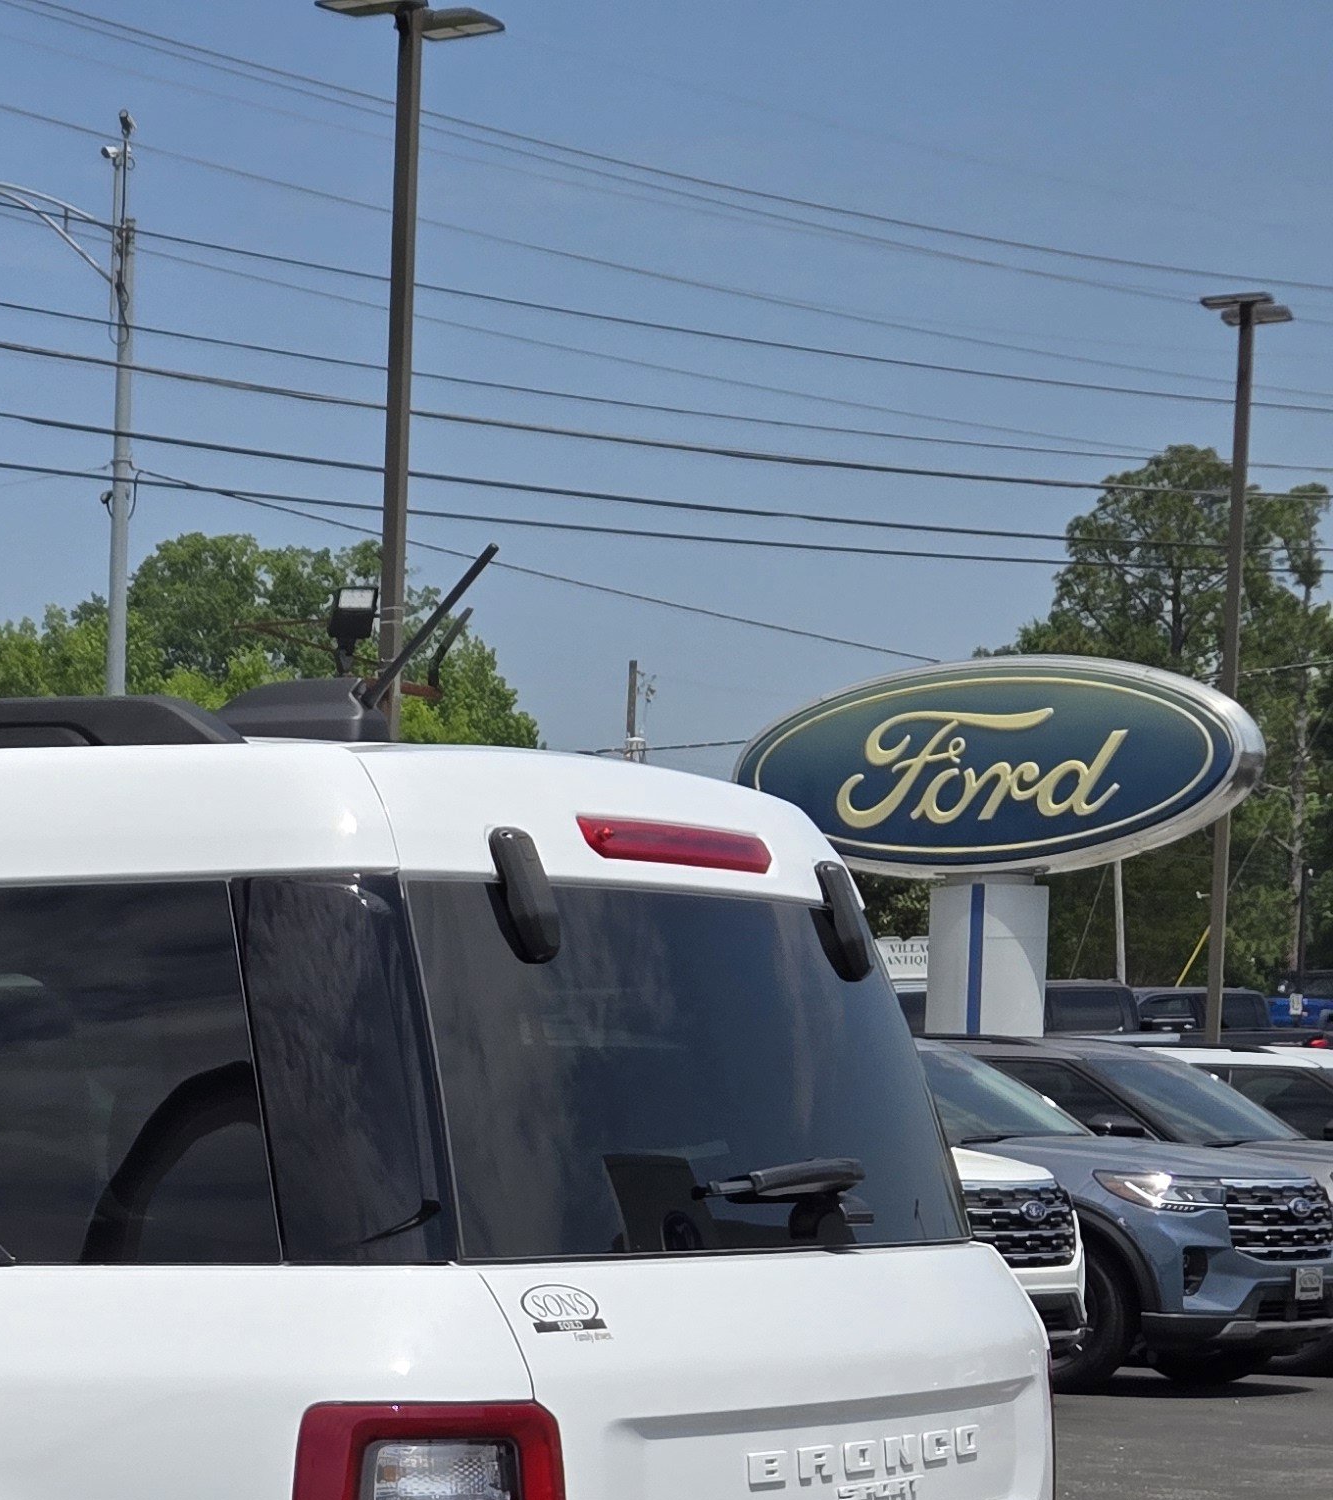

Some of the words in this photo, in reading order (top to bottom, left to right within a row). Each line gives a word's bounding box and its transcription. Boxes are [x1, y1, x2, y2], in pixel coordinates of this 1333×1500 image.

[836, 707, 1128, 829] Ford
[531, 1293, 590, 1317] SONS
[747, 1424, 979, 1486] BRONCO
